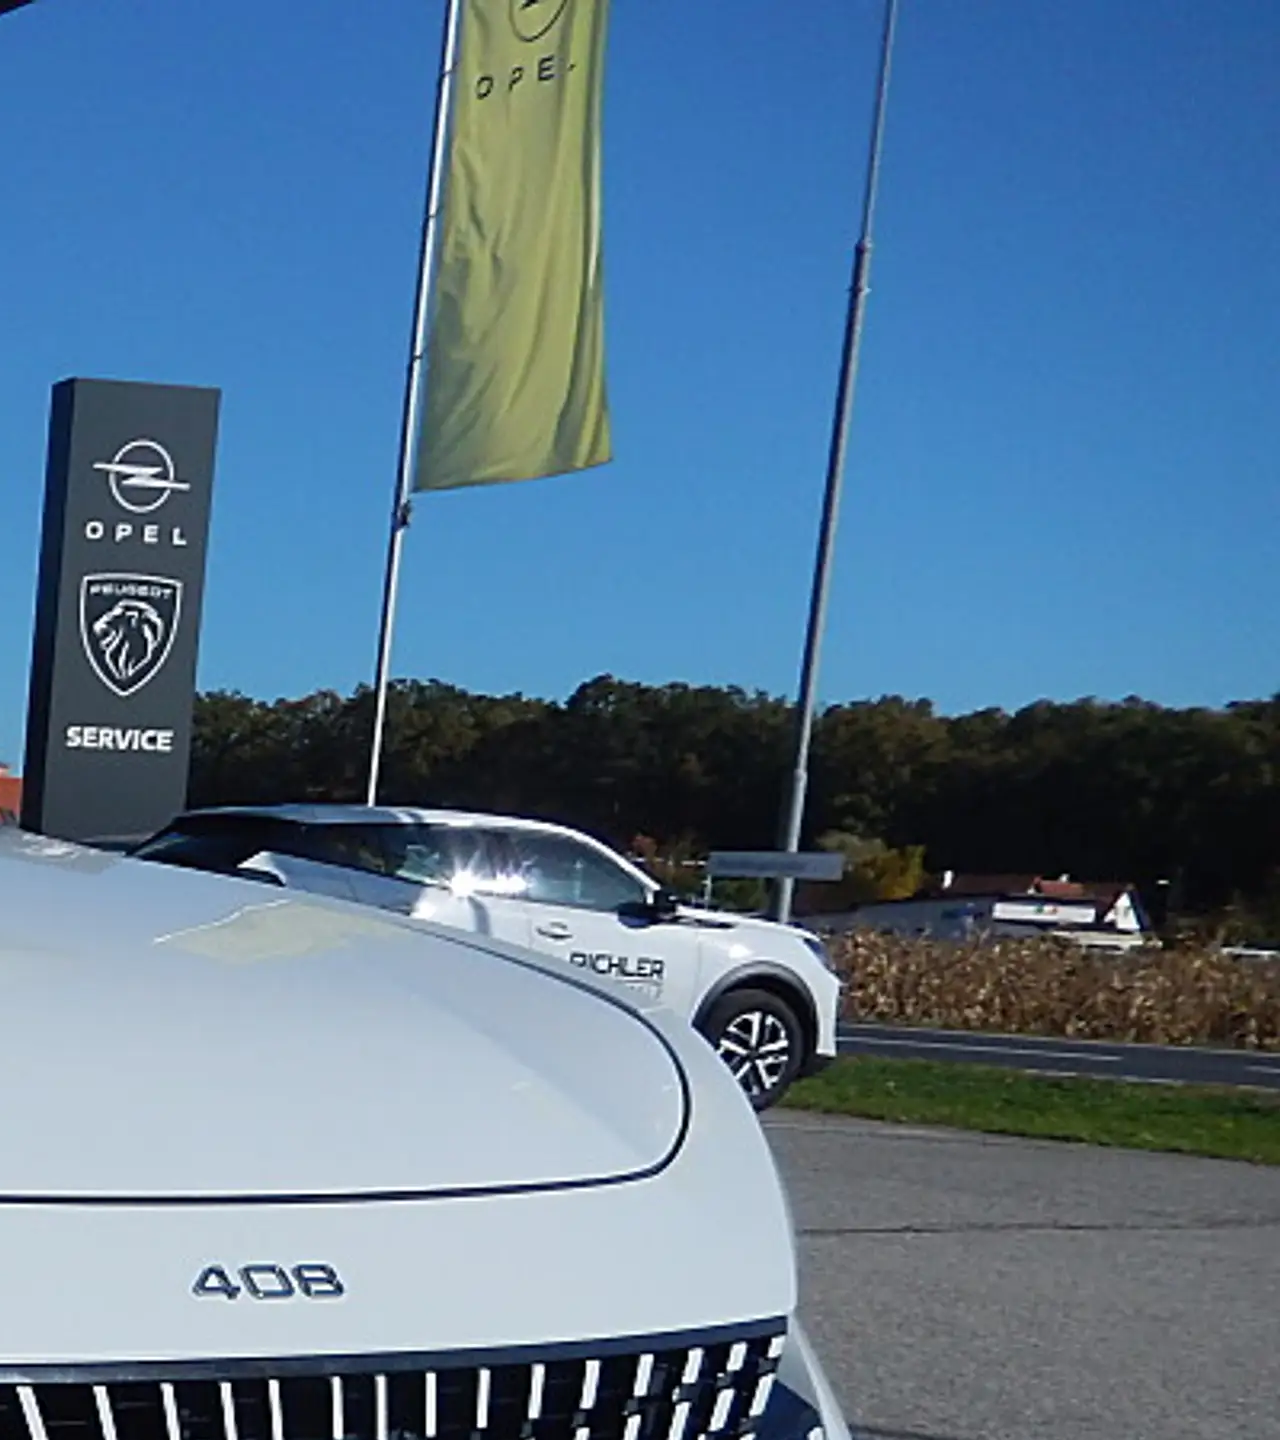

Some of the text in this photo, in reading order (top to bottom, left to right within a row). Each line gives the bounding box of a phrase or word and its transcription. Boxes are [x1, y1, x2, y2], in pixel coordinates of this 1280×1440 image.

[84, 519, 188, 546] OPEL
[89, 582, 174, 600] PEUGEOT
[65, 724, 176, 752] SERVICE
[192, 1262, 345, 1300] 408
